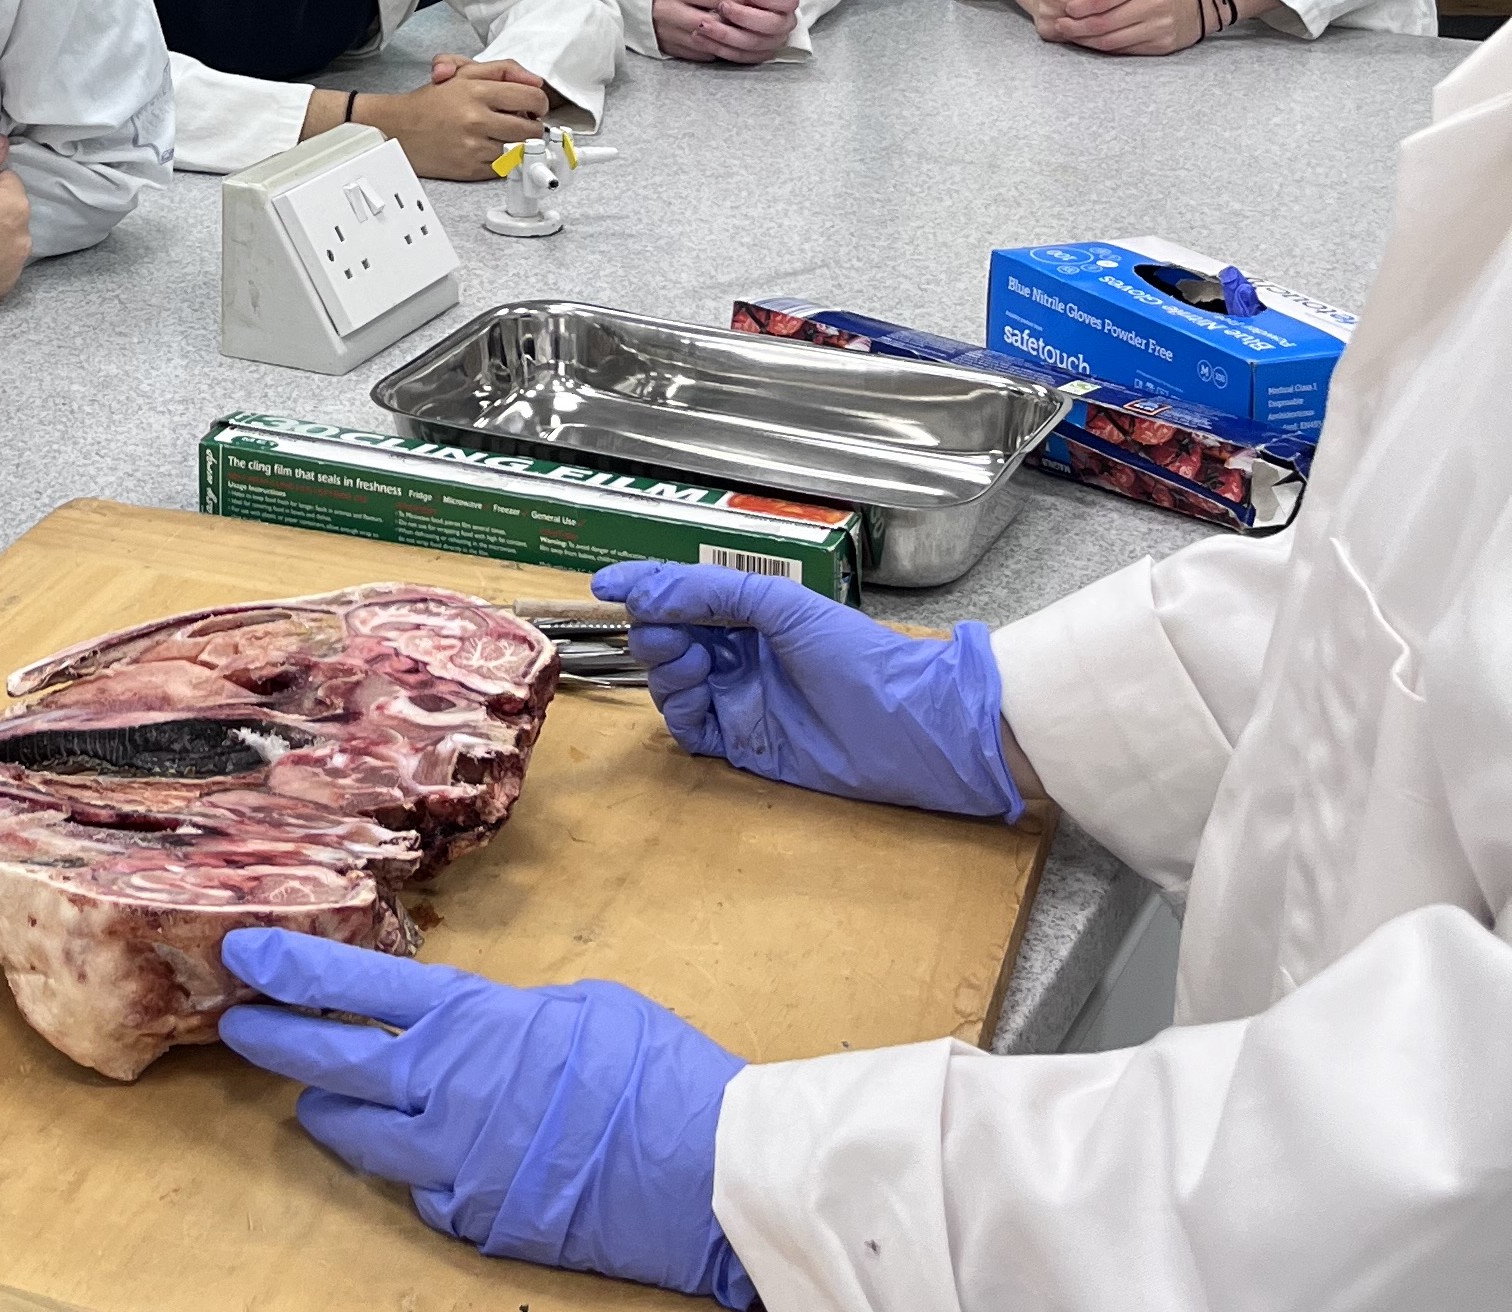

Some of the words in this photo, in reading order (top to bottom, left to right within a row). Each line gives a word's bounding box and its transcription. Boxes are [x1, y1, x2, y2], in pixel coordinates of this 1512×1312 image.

[1008, 276, 1031, 298] Blue
[1033, 286, 1065, 314] Nitrile
[1066, 304, 1102, 332] Gloves
[1104, 319, 1146, 349] Powder
[1147, 338, 1173, 362] Free
[1224, 325, 1276, 351] Blue
[1003, 324, 1091, 374] safetouch
[228, 455, 246, 468] The
[248, 460, 271, 476] cling
[274, 463, 293, 477] film
[295, 468, 314, 482] that
[317, 472, 340, 485] seals
[344, 476, 354, 488] in
[356, 478, 402, 497] freshness
[338, 432, 534, 472] CLING
[539, 465, 706, 503] FILM
[409, 489, 432, 502] Fridge
[443, 495, 483, 510] Microwave
[493, 504, 520, 516] Freezer
[531, 511, 559, 525] General
[561, 516, 577, 527] Use
